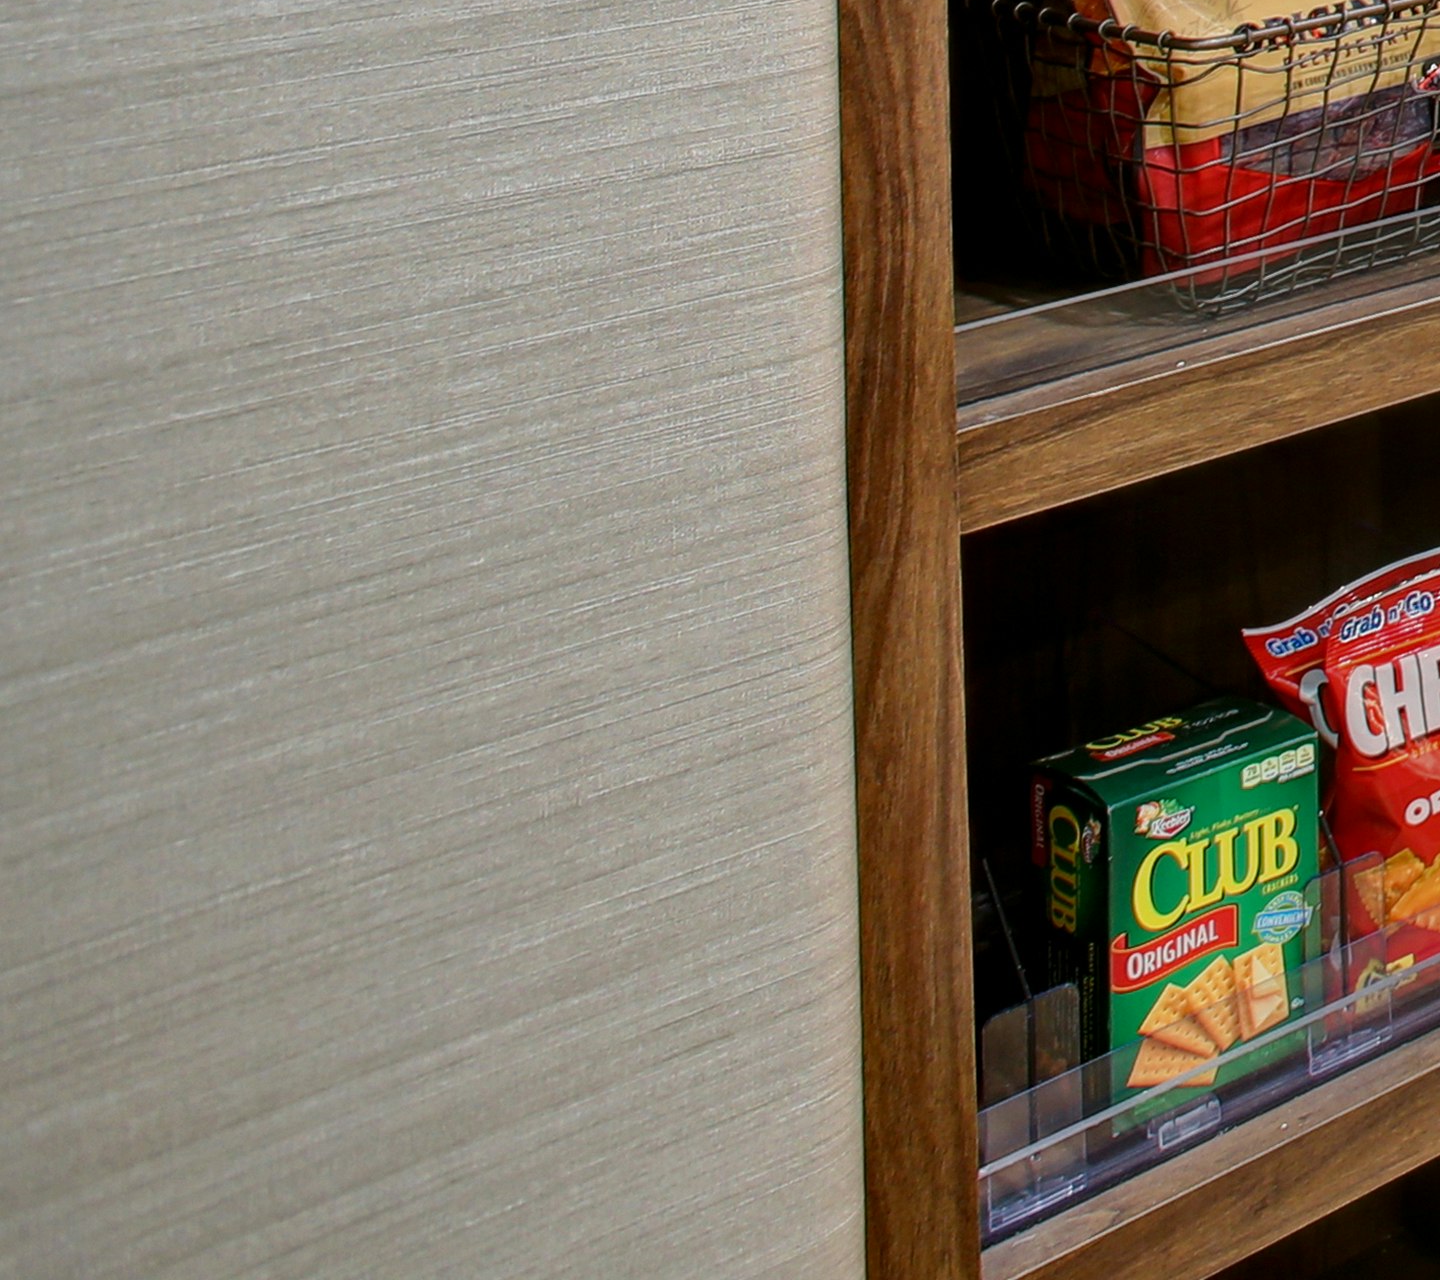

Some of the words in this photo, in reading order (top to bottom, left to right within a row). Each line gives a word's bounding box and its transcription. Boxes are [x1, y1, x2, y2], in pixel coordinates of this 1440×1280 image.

[1338, 613, 1382, 642] Grab
[1404, 591, 1433, 615] Go
[1267, 629, 1315, 658] Grab
[1132, 806, 1299, 931] CLUB
[1125, 923, 1220, 979] ORIGINAL
